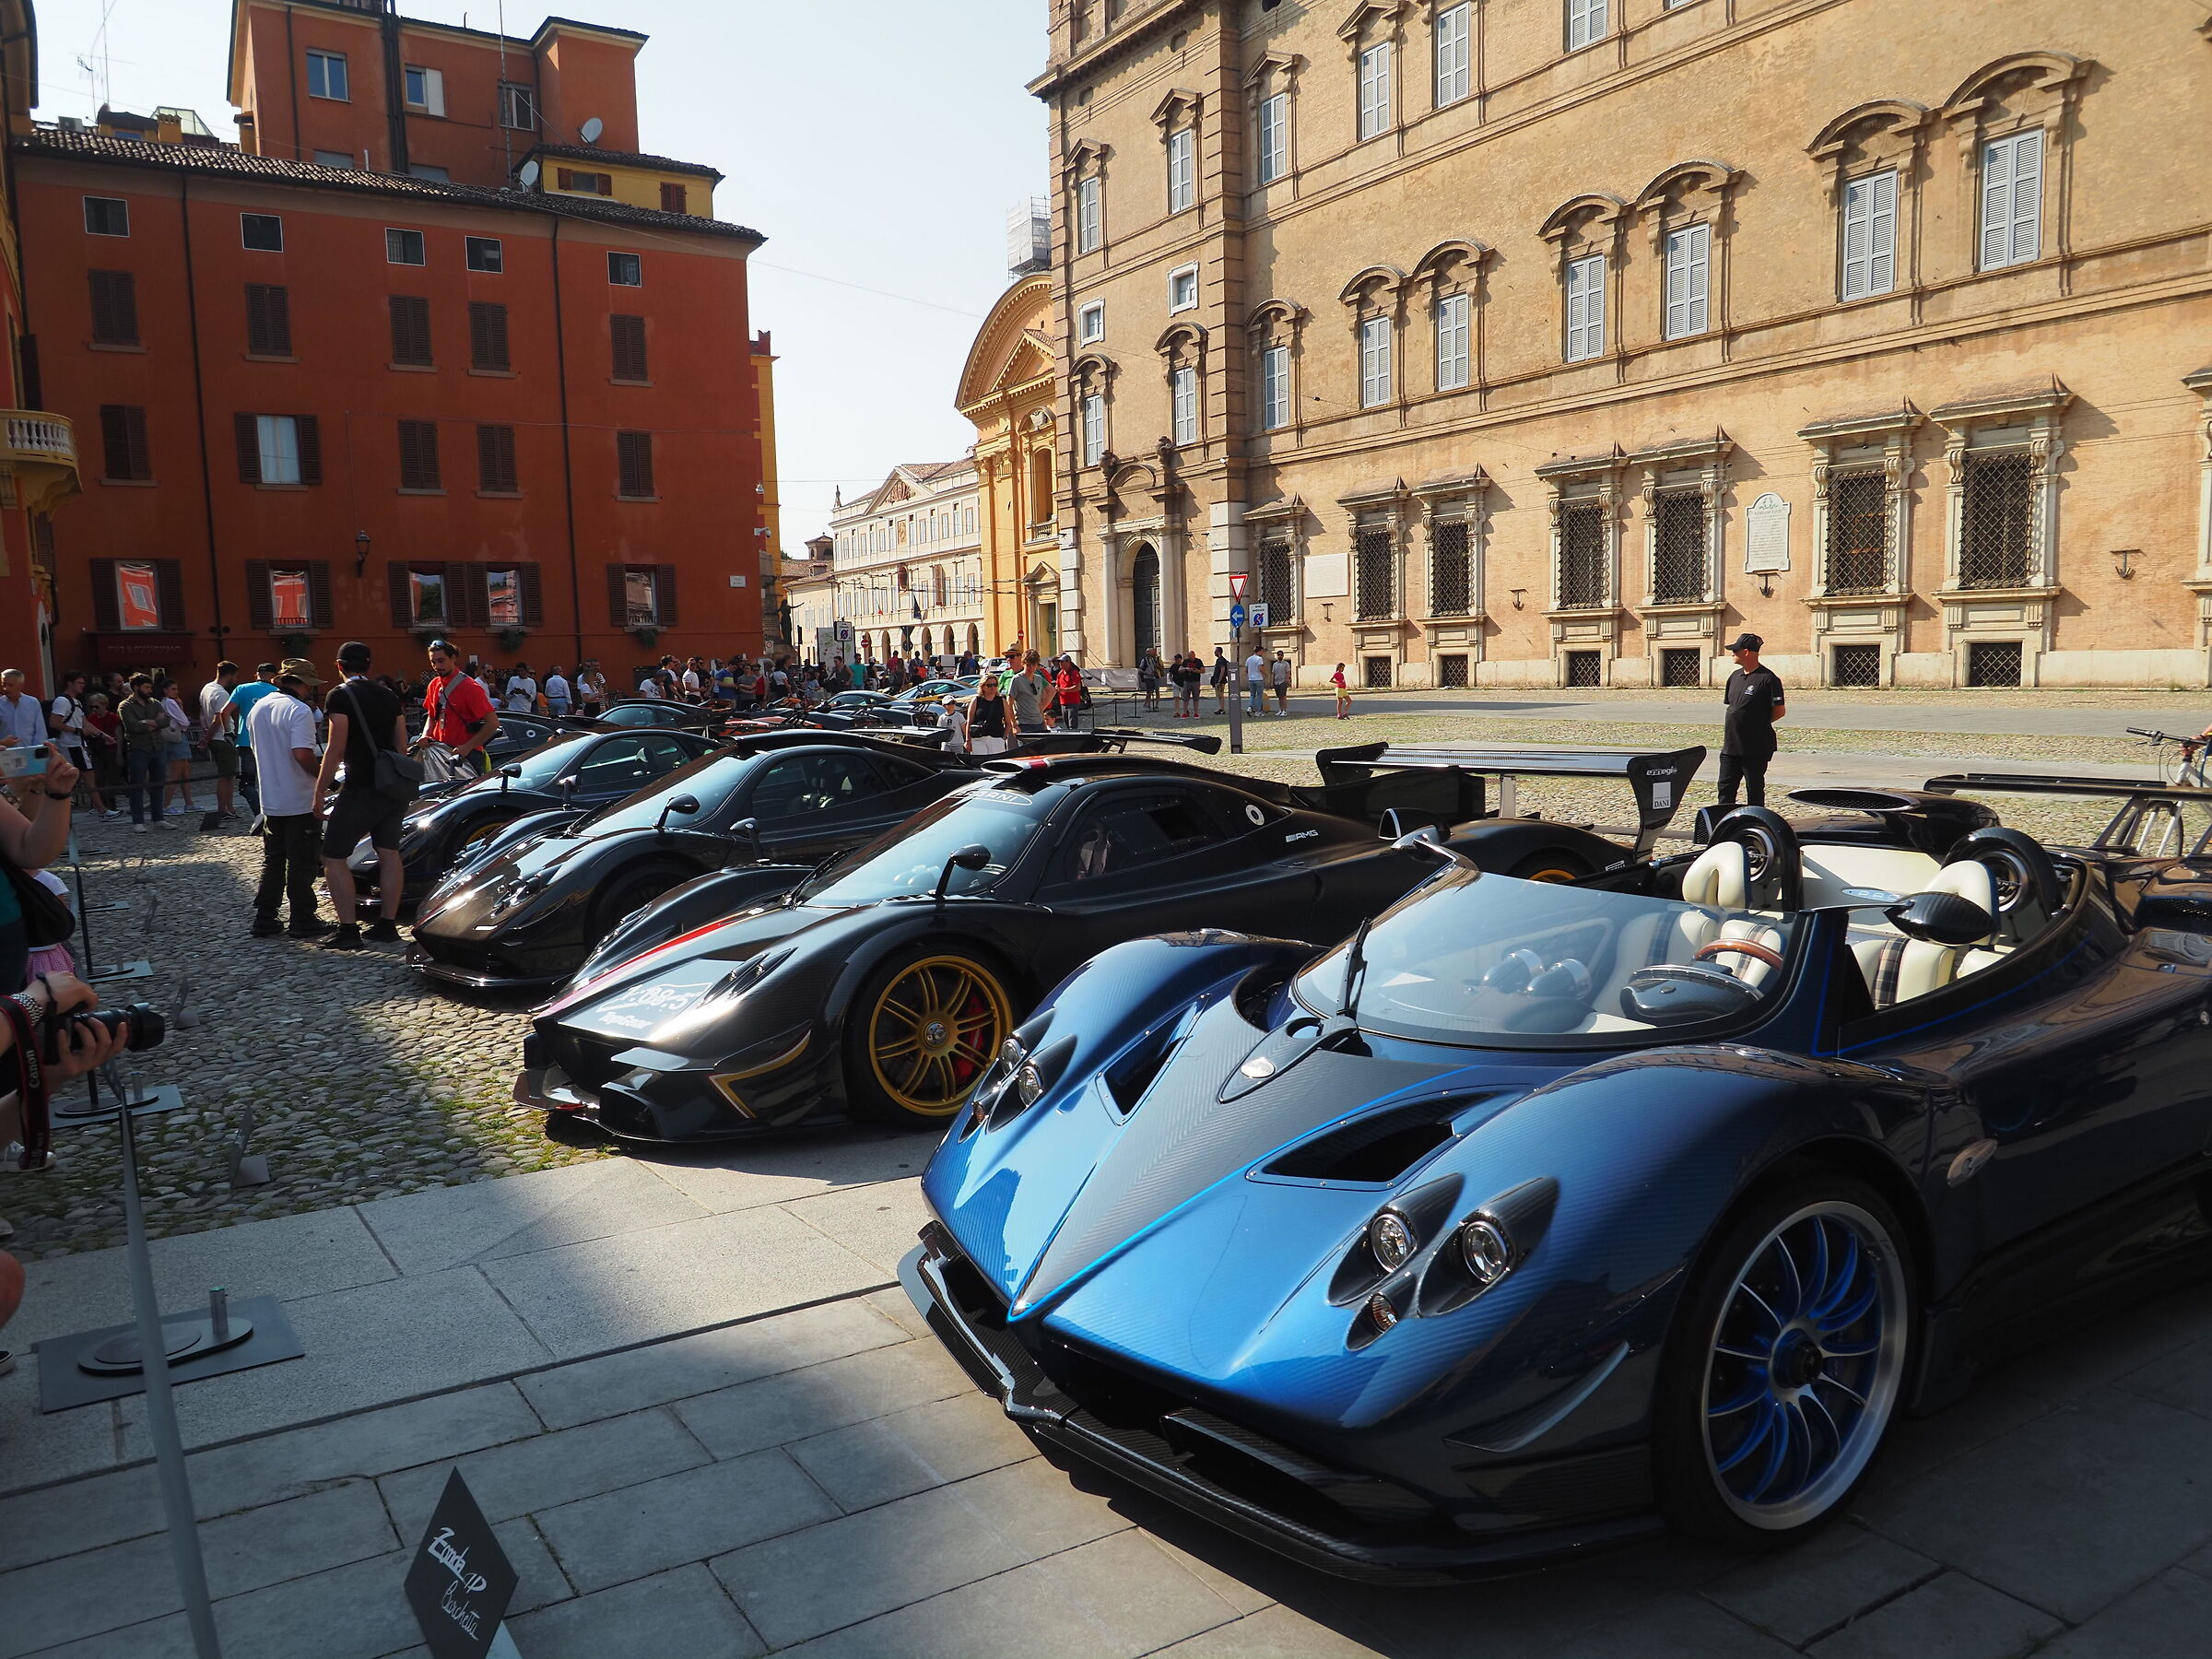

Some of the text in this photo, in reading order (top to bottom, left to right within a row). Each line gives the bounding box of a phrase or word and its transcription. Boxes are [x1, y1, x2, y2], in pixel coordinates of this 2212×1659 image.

[1653, 799, 1670, 808] DANI
[1295, 830, 1319, 841] AMG
[26, 1049, 40, 1088] Canon
